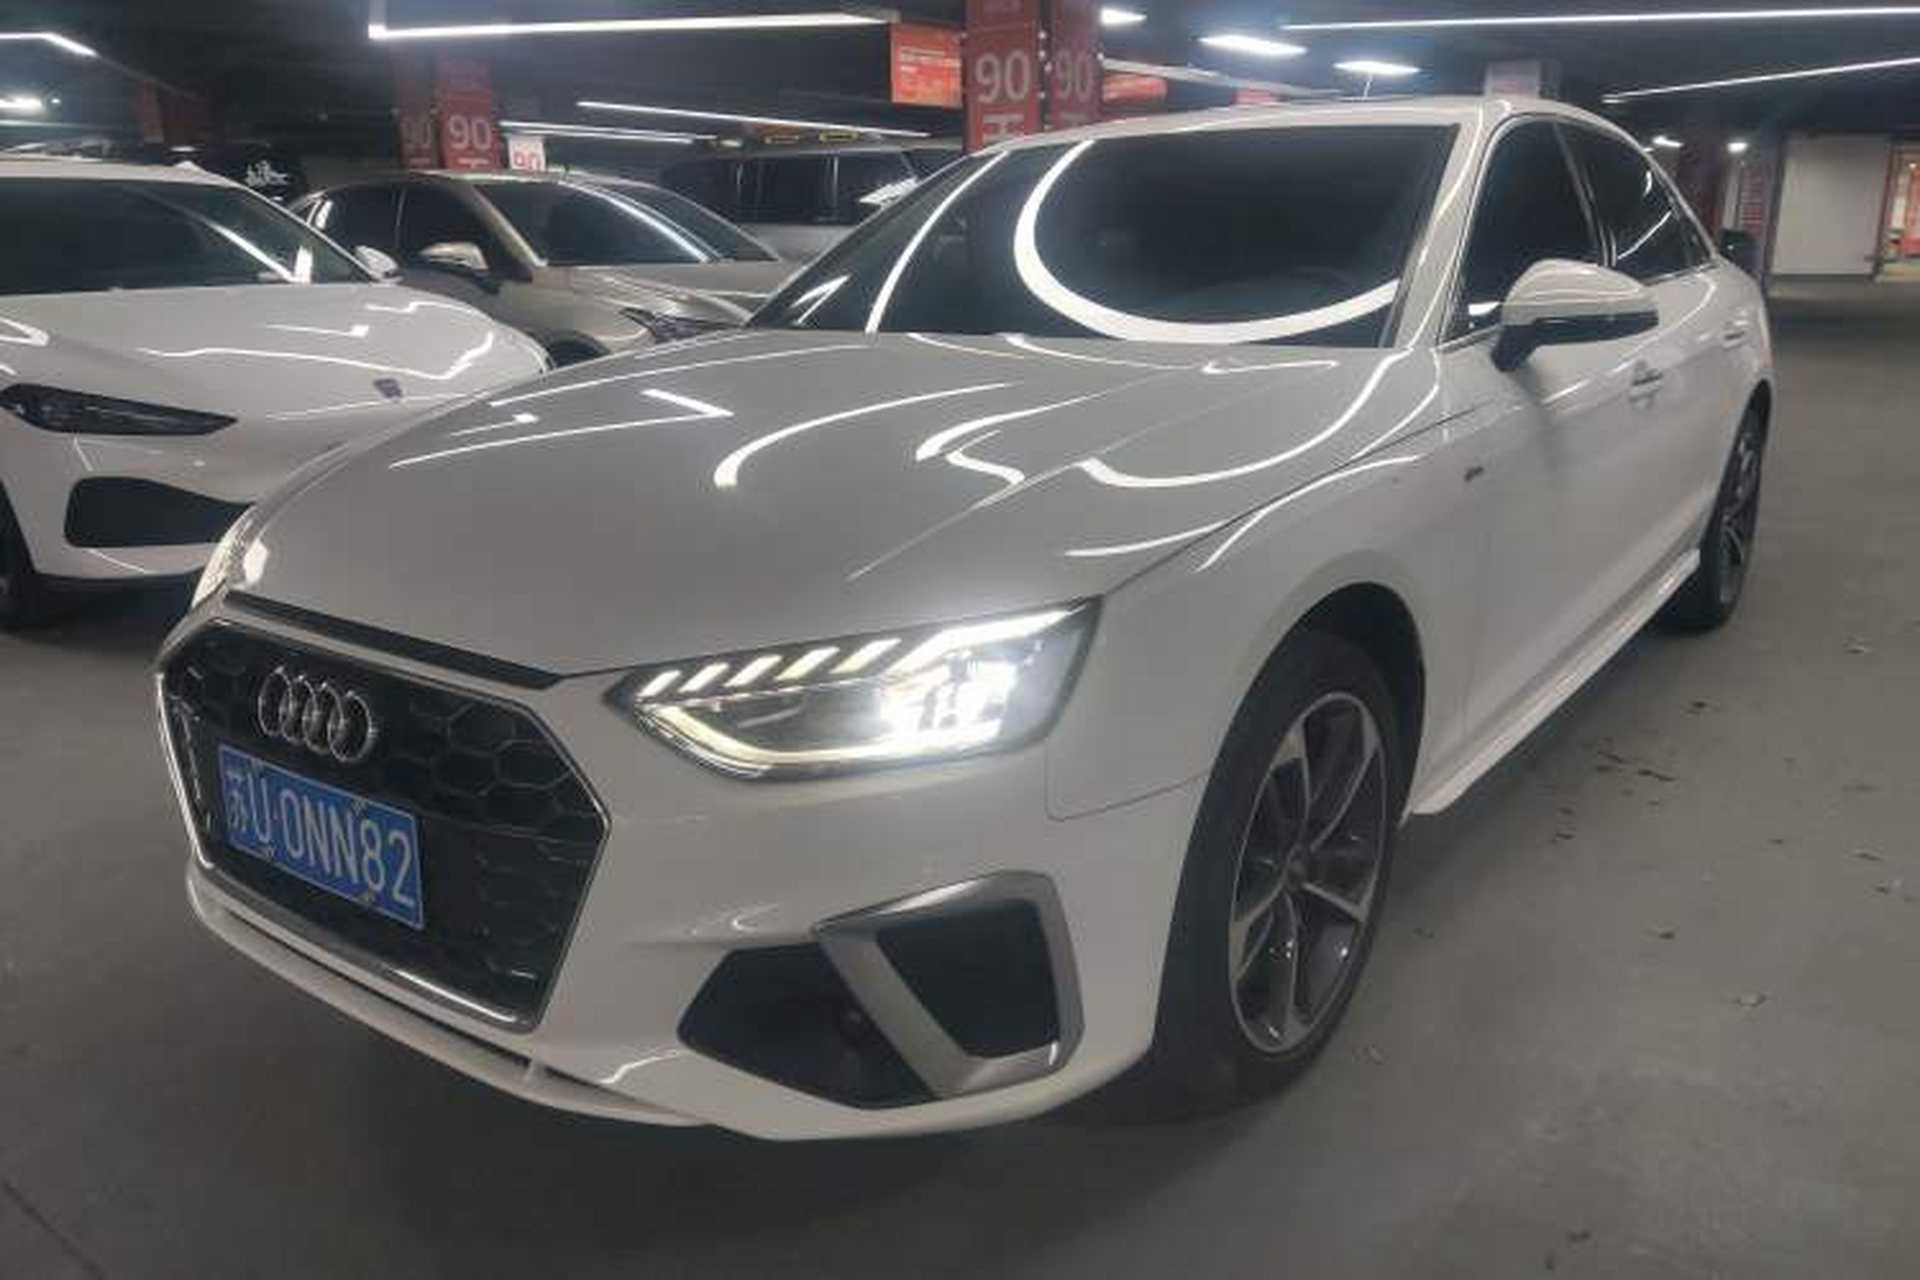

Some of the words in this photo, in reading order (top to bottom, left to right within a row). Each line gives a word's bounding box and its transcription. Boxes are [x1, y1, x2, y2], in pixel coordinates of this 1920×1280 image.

[975, 50, 1030, 104] 90
[1055, 50, 1094, 101] 90
[448, 114, 492, 151] 90
